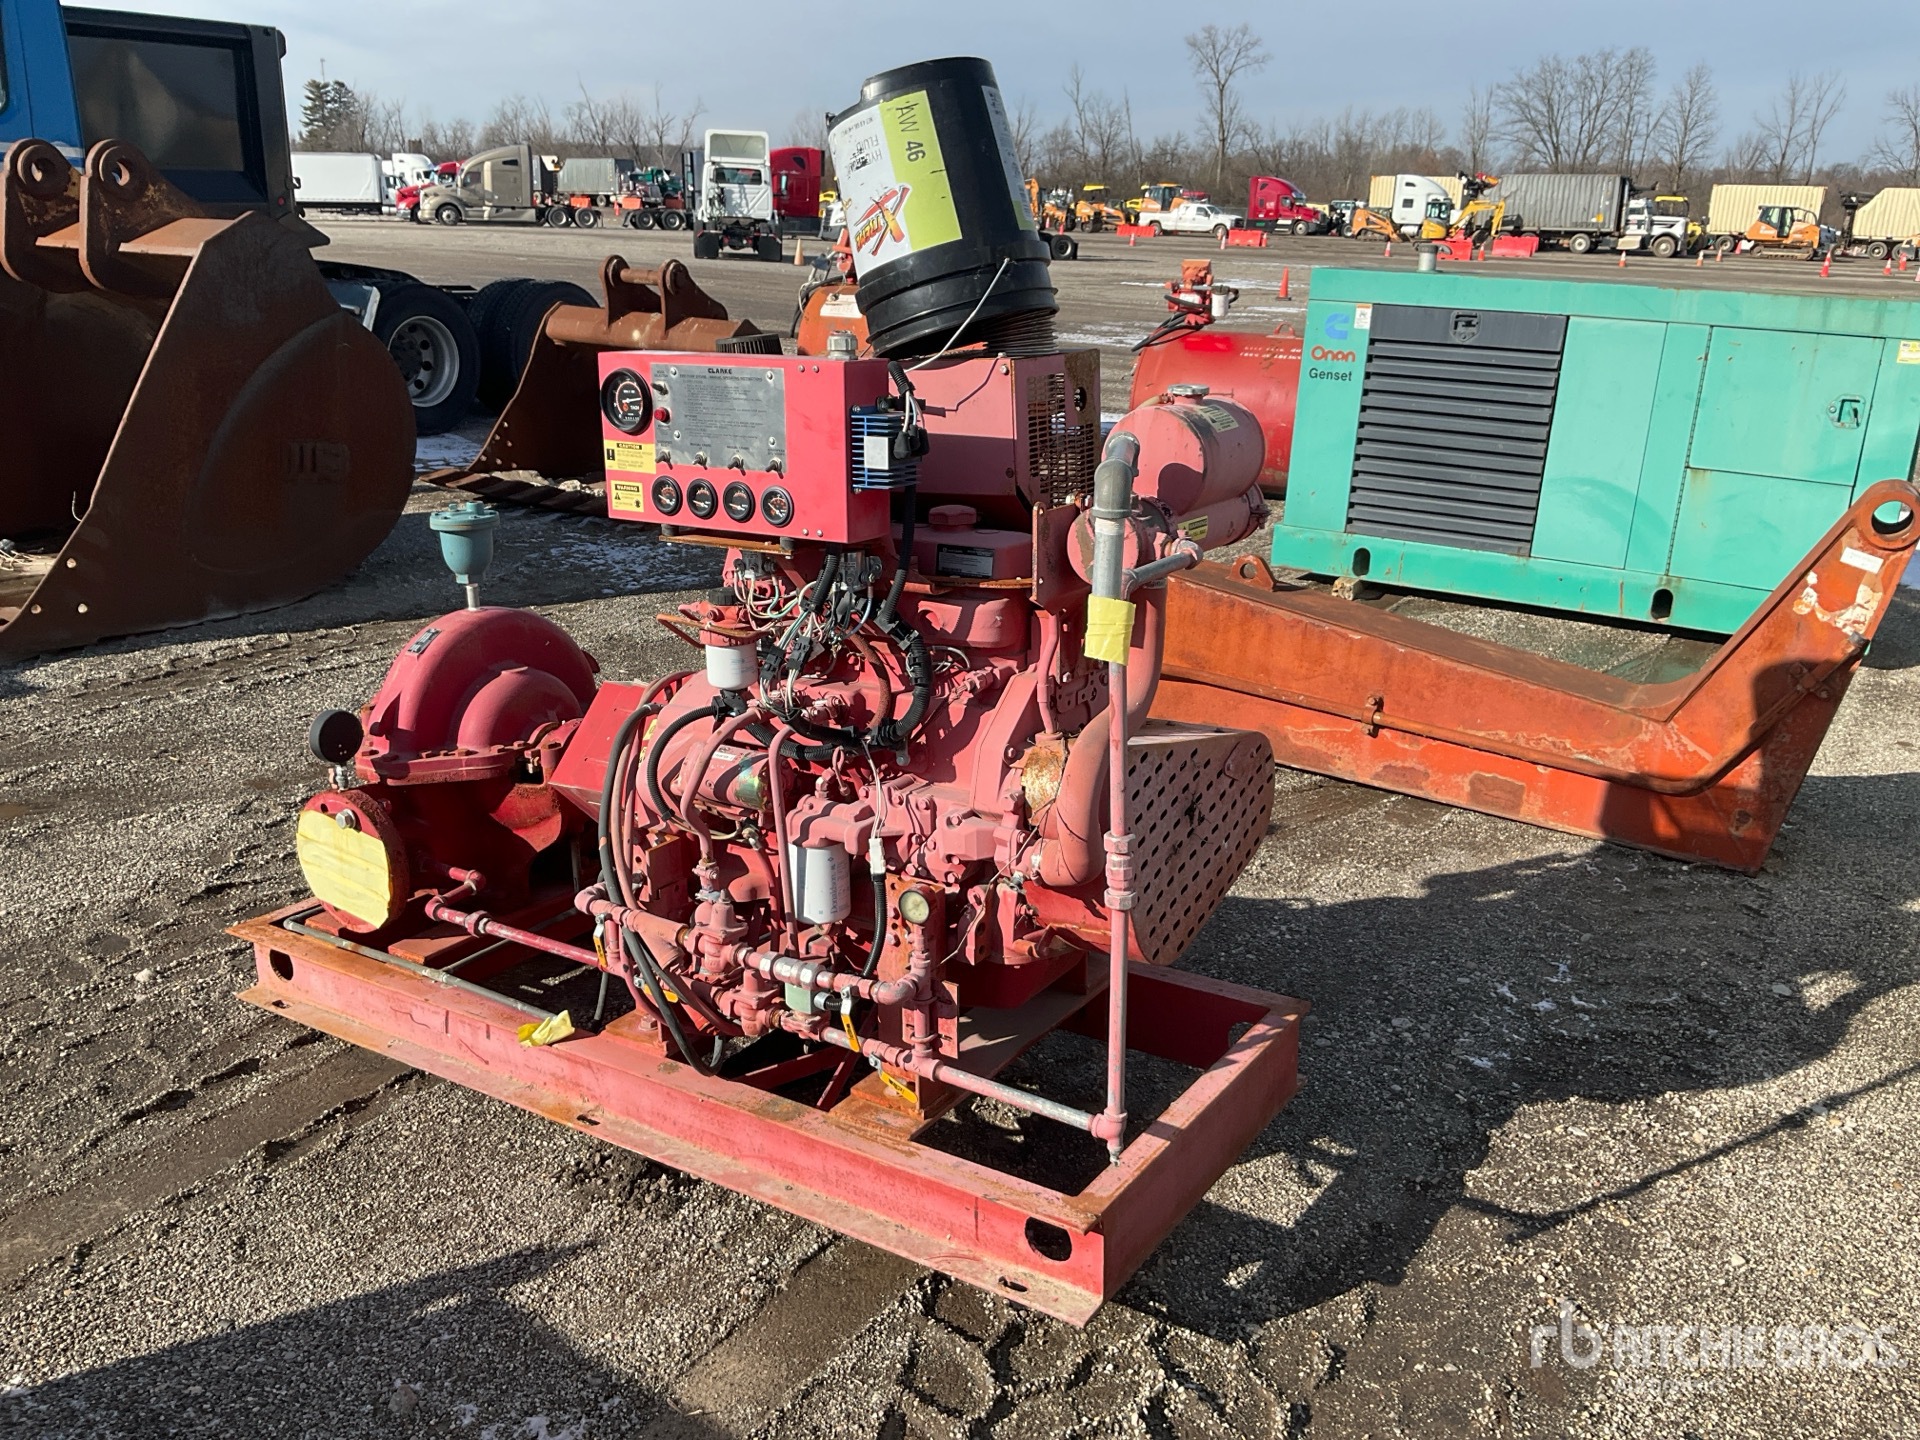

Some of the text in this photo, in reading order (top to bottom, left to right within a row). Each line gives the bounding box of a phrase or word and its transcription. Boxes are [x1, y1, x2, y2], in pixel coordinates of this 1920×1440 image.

[906, 141, 926, 162] 46
[1311, 345, 1356, 363] Onan
[707, 367, 733, 375] CLARKE
[1309, 367, 1353, 382] Genset
